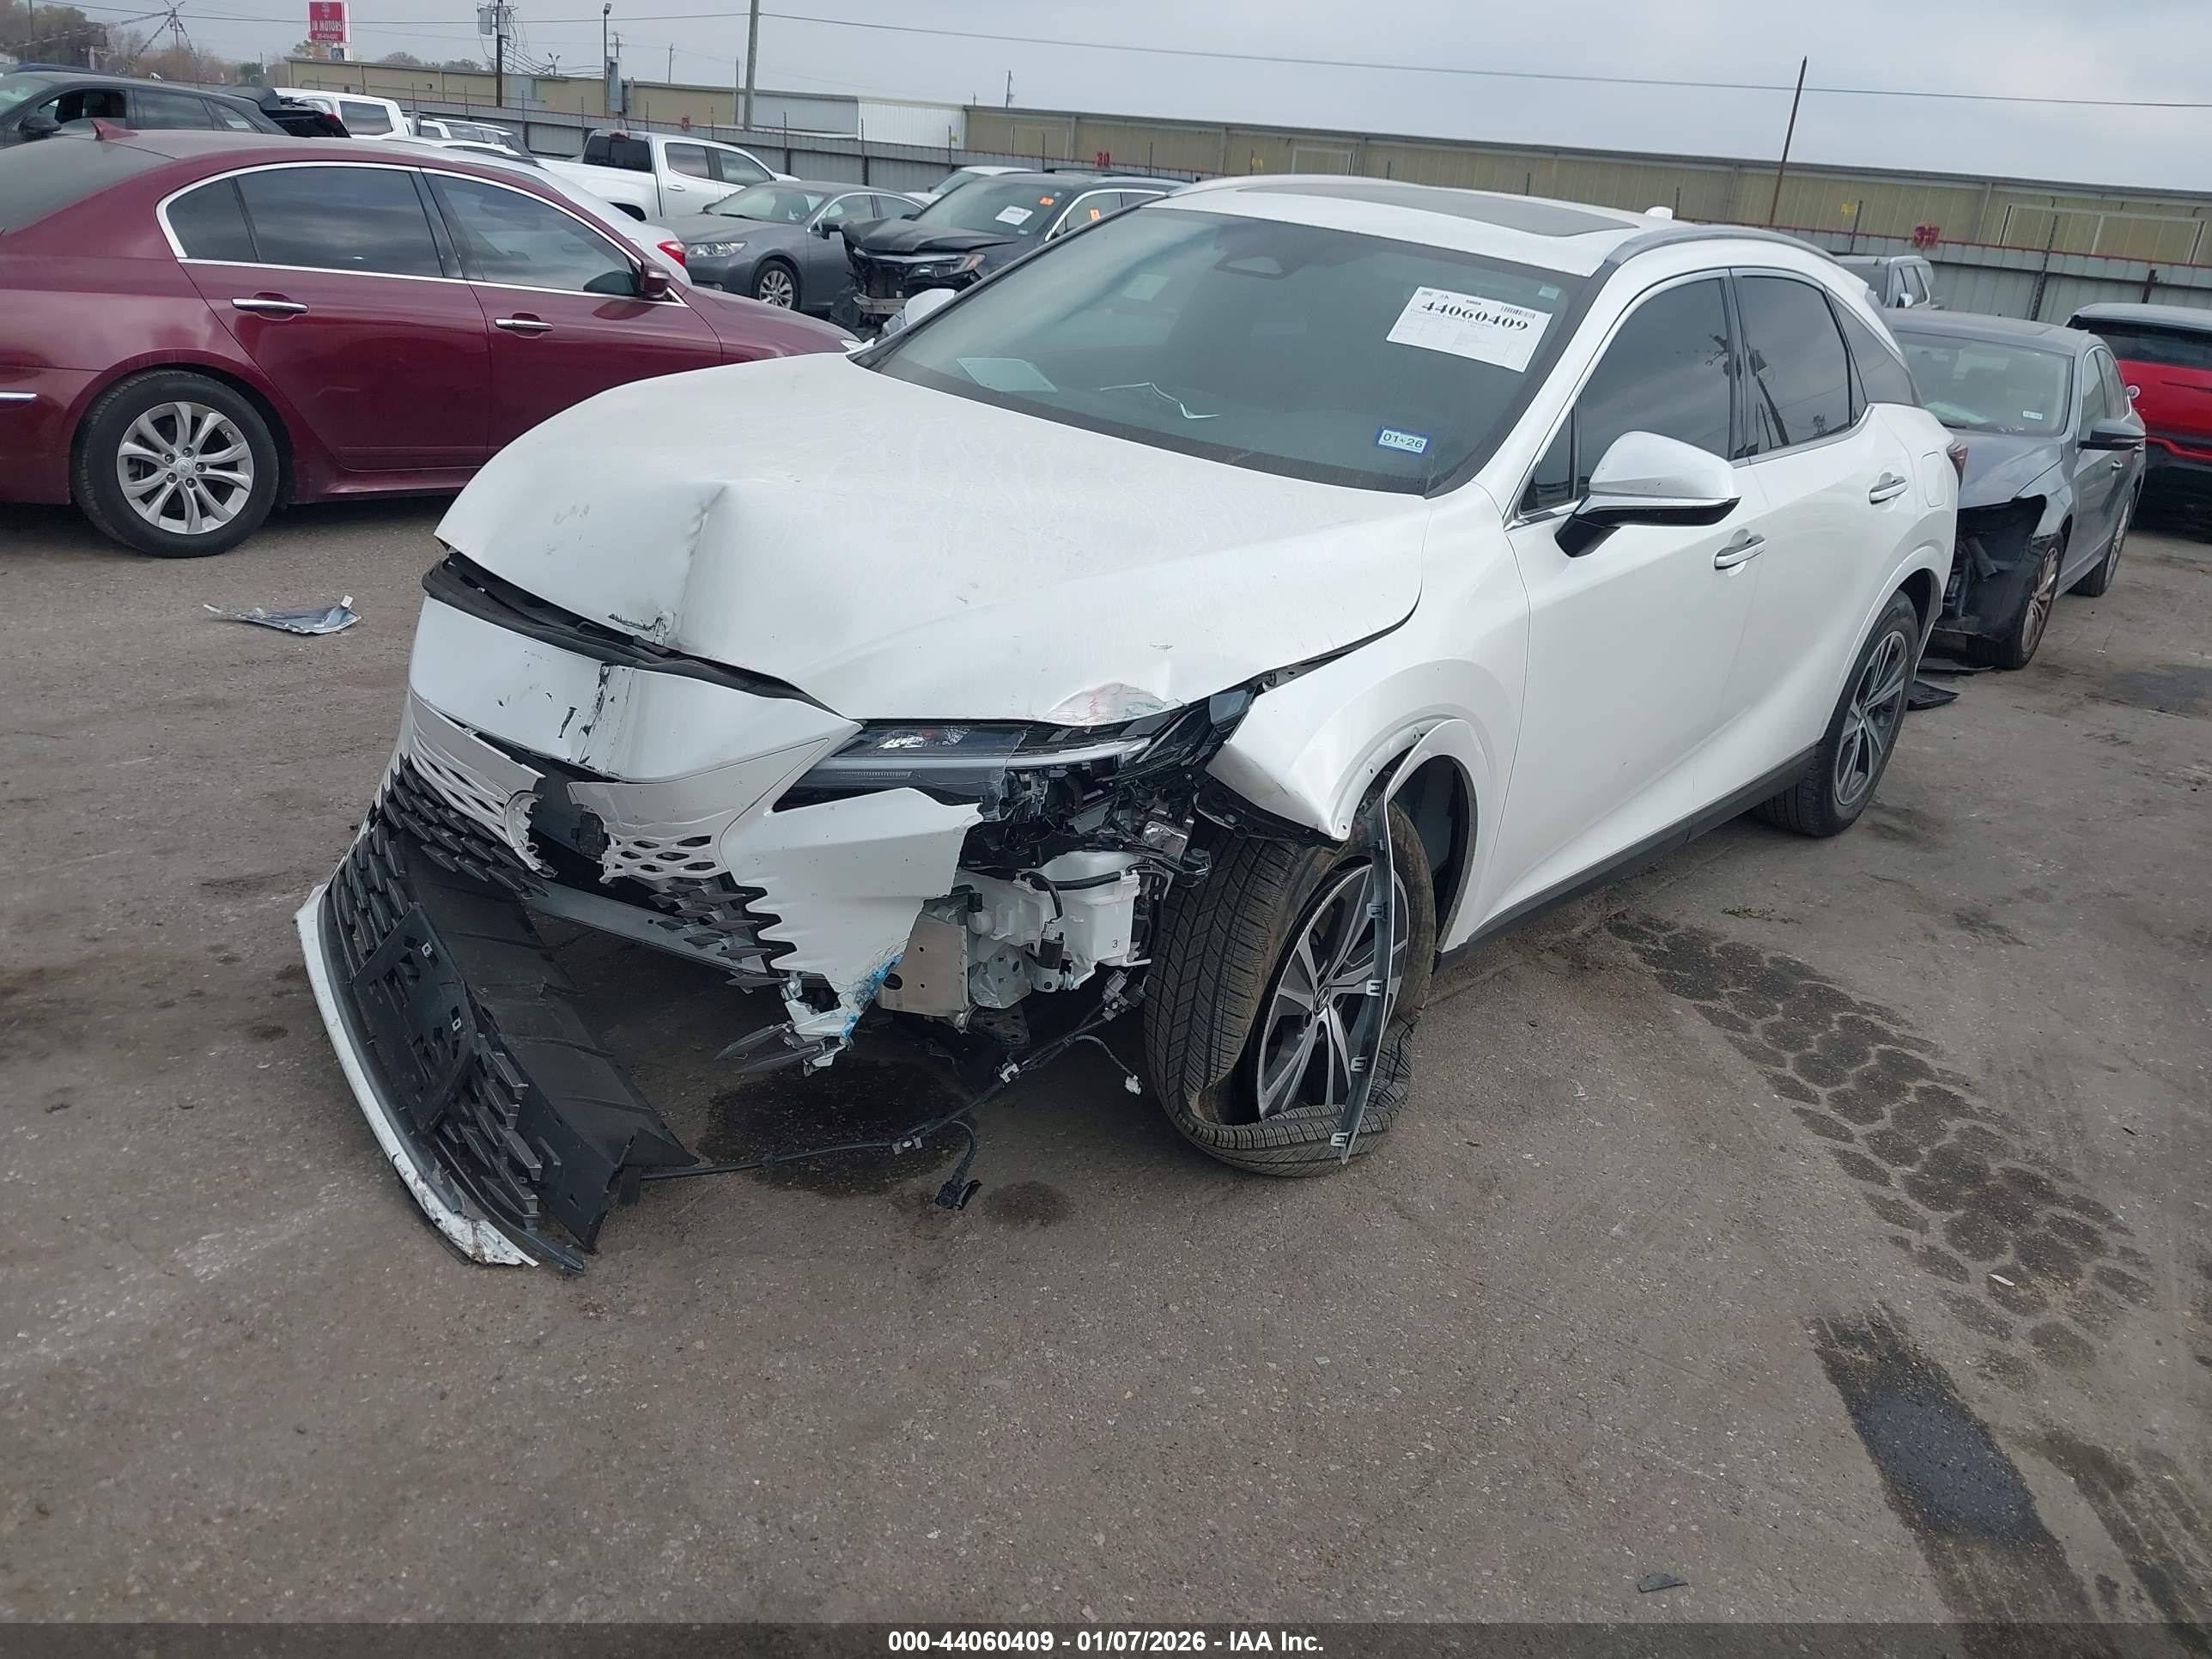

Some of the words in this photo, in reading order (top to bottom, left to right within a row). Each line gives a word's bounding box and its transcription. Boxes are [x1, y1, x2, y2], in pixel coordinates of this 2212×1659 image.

[319, 21, 342, 32] MOTORS
[1422, 301, 1528, 331] 44060409
[1112, 939, 1118, 949] 3
